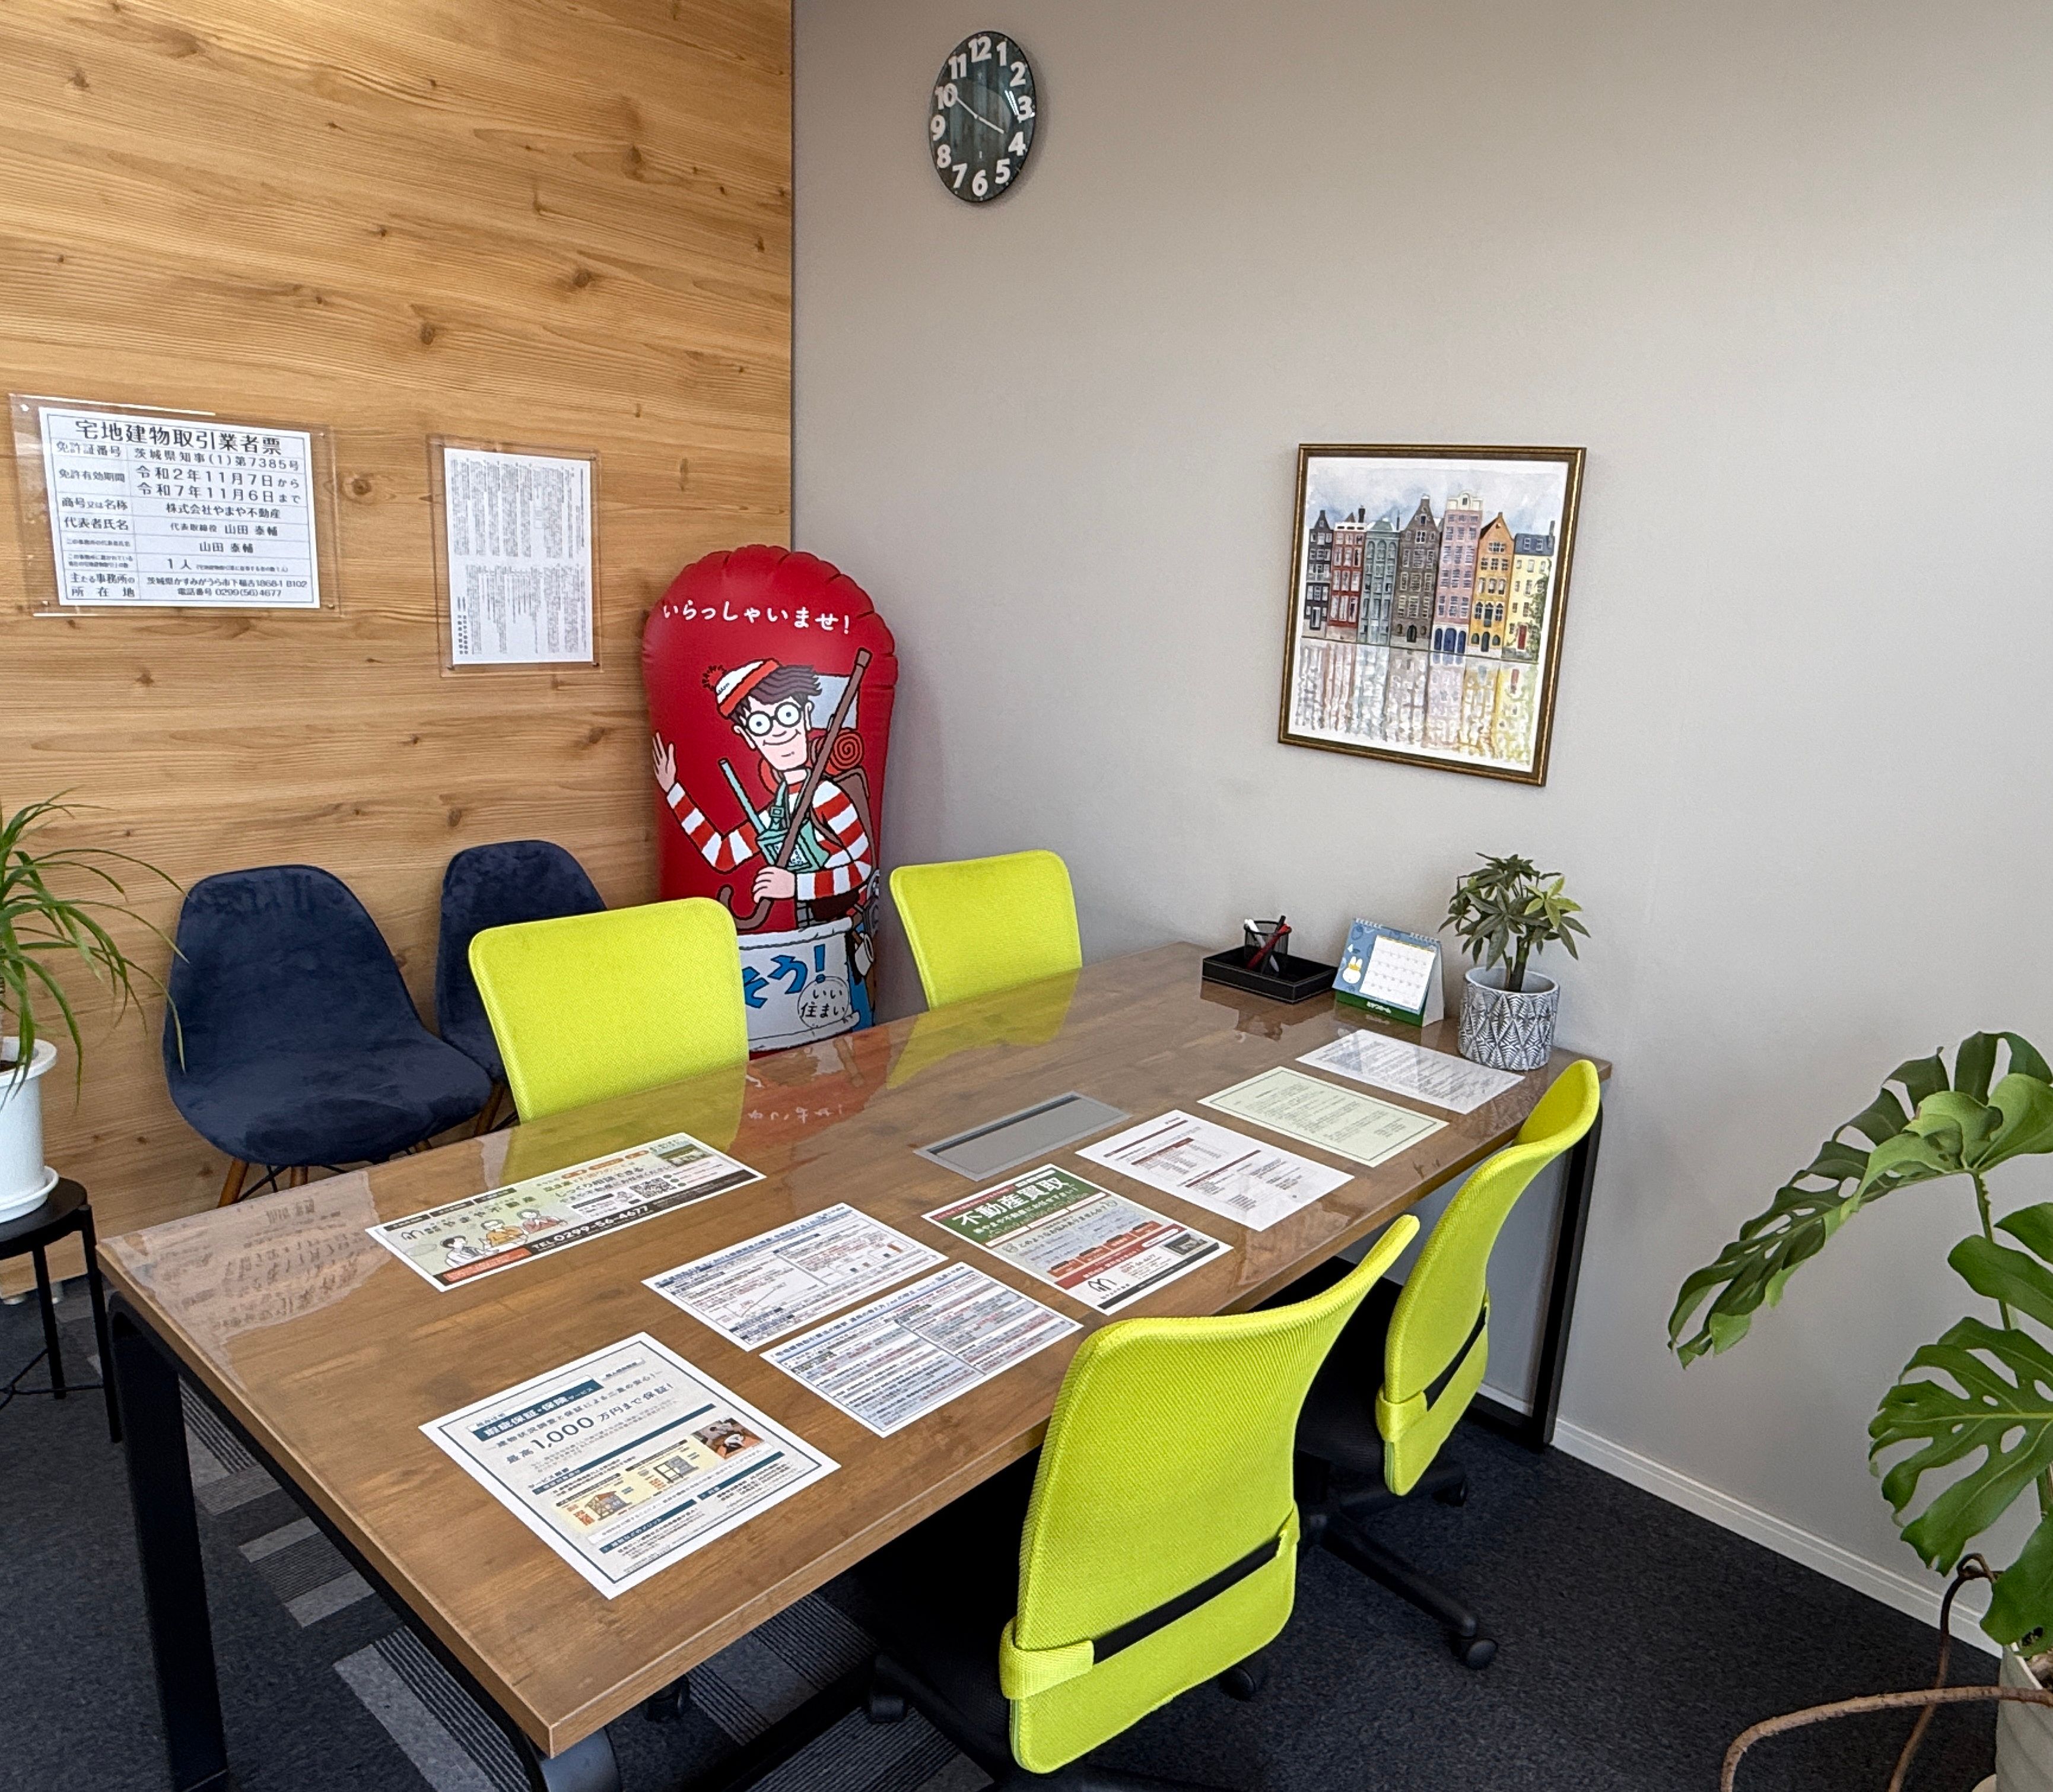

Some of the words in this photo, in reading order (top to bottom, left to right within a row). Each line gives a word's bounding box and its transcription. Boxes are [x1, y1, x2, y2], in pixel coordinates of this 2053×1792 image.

[968, 36, 991, 62] 12
[996, 42, 1008, 66] 1
[948, 53, 967, 80] 11
[1010, 61, 1026, 86] 2
[935, 83, 958, 110] 10
[1017, 96, 1032, 122] 3
[930, 115, 946, 141] 9
[937, 144, 951, 169] 8
[1008, 131, 1026, 156] 4
[952, 163, 967, 189] 7
[972, 170, 989, 197] 6
[995, 158, 1010, 184] 5
[56, 441, 121, 457] 免許証番号
[75, 420, 281, 455] 宅地建物取引業者票
[135, 465, 299, 489] 令和2年11月7日から
[137, 482, 301, 504] 令和7年11月6日まで
[64, 516, 128, 530] 代表者氏名
[166, 503, 280, 519] 株式会社やまや不動産
[663, 599, 850, 634] いらっしゃいませ!
[812, 989, 843, 999] いい
[800, 1001, 845, 1018] 住まい
[946, 1175, 1073, 1228] 不動産買取
[529, 1415, 599, 1451] 1,000
